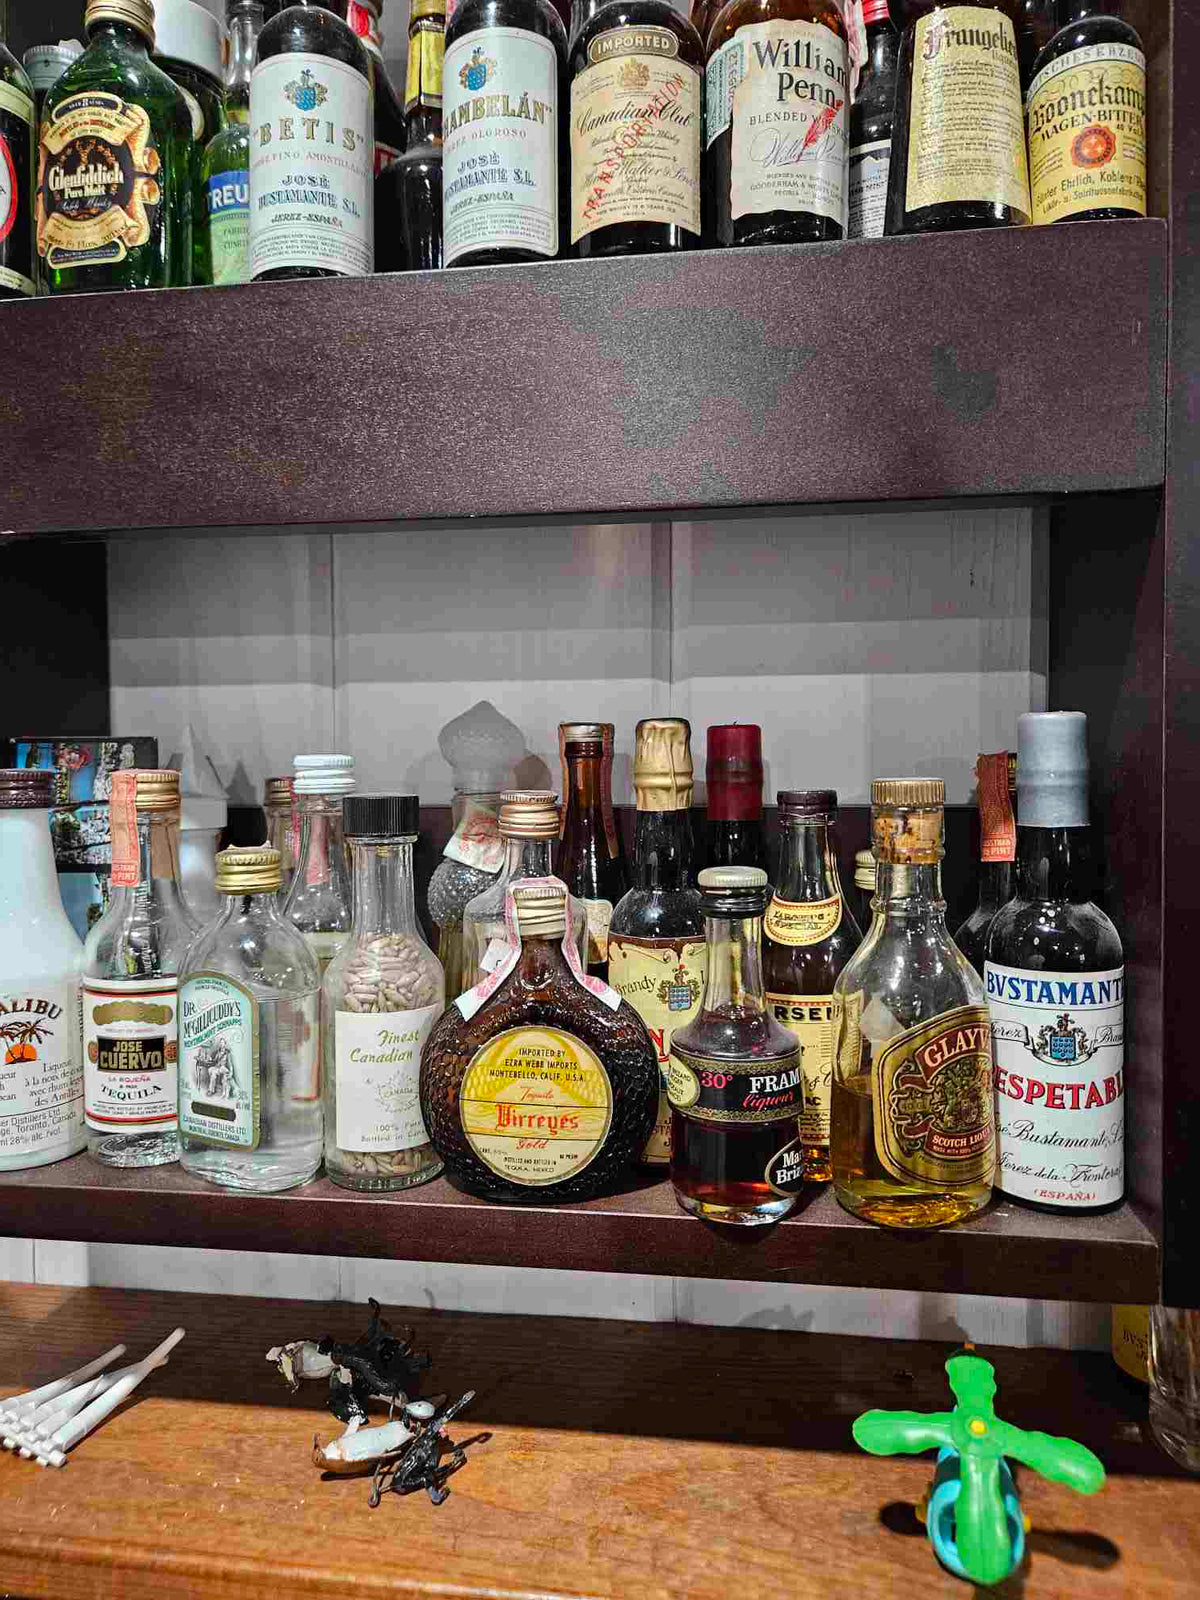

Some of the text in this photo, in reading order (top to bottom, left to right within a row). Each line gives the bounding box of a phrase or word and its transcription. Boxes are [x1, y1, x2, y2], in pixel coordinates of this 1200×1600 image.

[598, 35, 670, 55] IMPORTED
[777, 72, 837, 110] Penn
[577, 100, 653, 137] Canadian
[749, 112, 808, 126] BLENDED
[48, 162, 124, 192] Glenfiddich
[282, 174, 330, 189] JOSÉ
[987, 971, 1124, 1006] BVSTAMANT
[0, 998, 63, 1020] ALIBU
[378, 1030, 420, 1047] Finest
[113, 1041, 143, 1053] JOSE
[350, 1047, 414, 1063] Canadian
[518, 1048, 566, 1058] IMPORTED BY
[99, 1051, 163, 1070] CUERVO
[505, 1058, 523, 1068] EZRA
[547, 1061, 578, 1070] IMPORTS
[489, 1070, 539, 1081] MONTEBELLO,
[700, 1072, 734, 1090] 30°
[101, 1085, 163, 1101] TEQUILA
[994, 1066, 1124, 1111] ESPETABL
[35, 1096, 48, 1107] des
[11, 1114, 47, 1127] Distillers
[932, 1134, 967, 1148] SCOTCH
